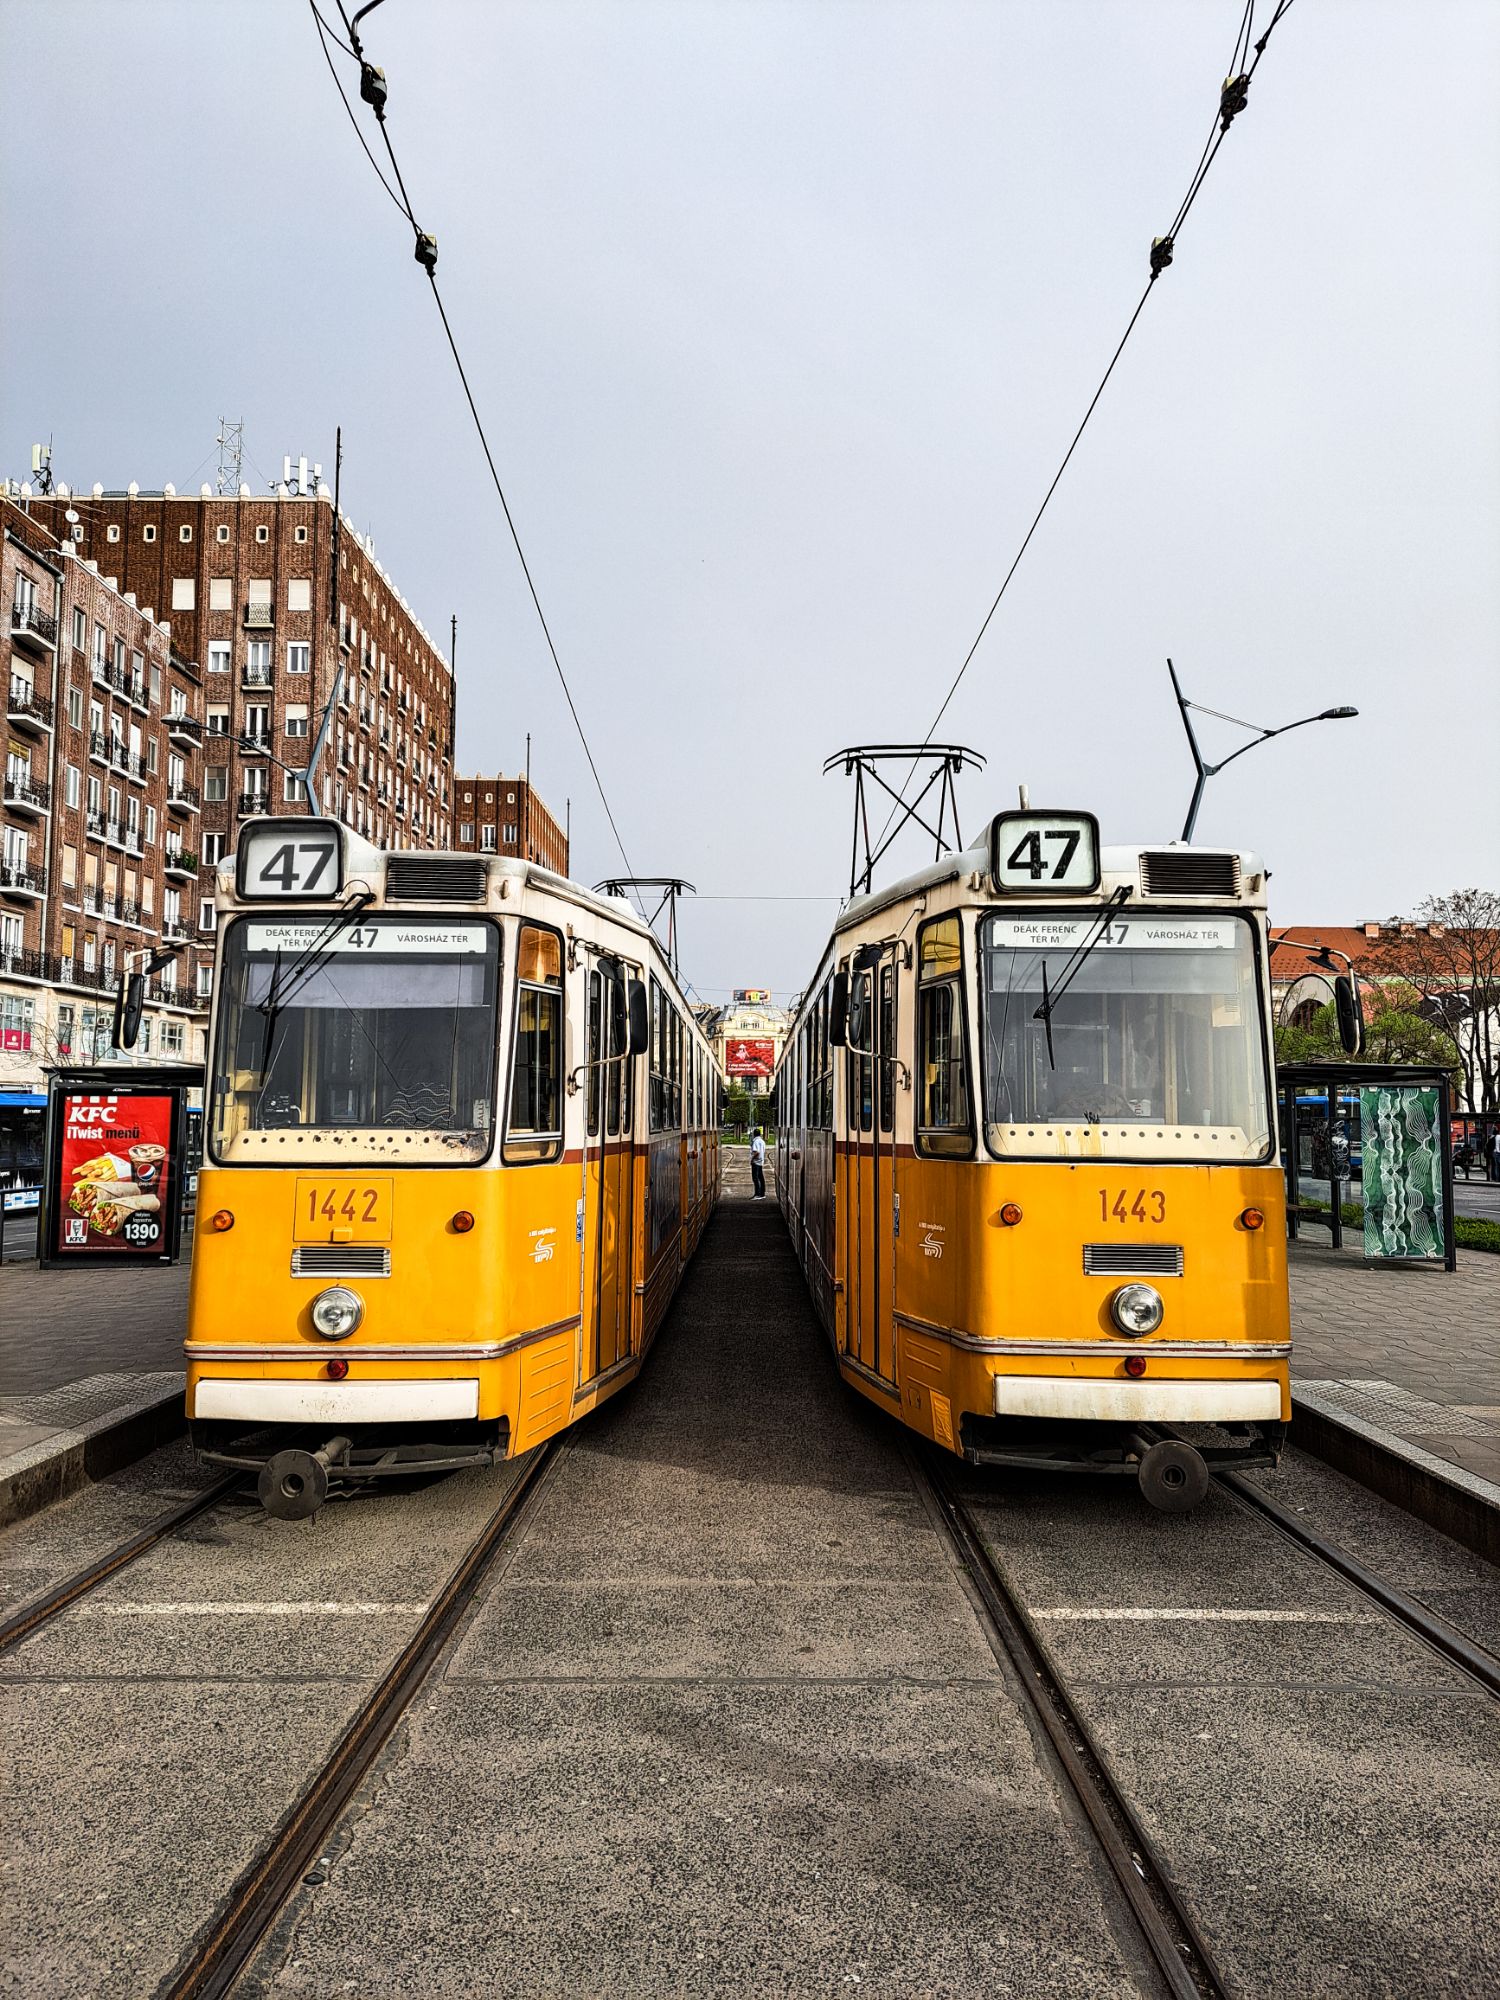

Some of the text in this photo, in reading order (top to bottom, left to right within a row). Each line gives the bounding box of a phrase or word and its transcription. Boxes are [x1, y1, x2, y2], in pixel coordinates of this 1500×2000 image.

[1007, 830, 1081, 880] 47
[259, 843, 335, 891] 47
[265, 927, 330, 938] DEÁK FERENC
[396, 931, 468, 943] VÁROSHÁZ TÉR
[1013, 924, 1077, 934] DEÁK FERENC
[1098, 924, 1130, 945] 47
[1146, 929, 1219, 940] VÁROSHÁZ TÉR
[283, 937, 313, 948] TÉR M
[347, 928, 379, 949] 47
[1030, 934, 1060, 944] TÉR M
[68, 1106, 118, 1123] KFC
[66, 1126, 140, 1139] iTwist menü
[309, 1188, 379, 1223] 1442
[1098, 1189, 1166, 1224] 1443
[124, 1223, 160, 1240] 1390
